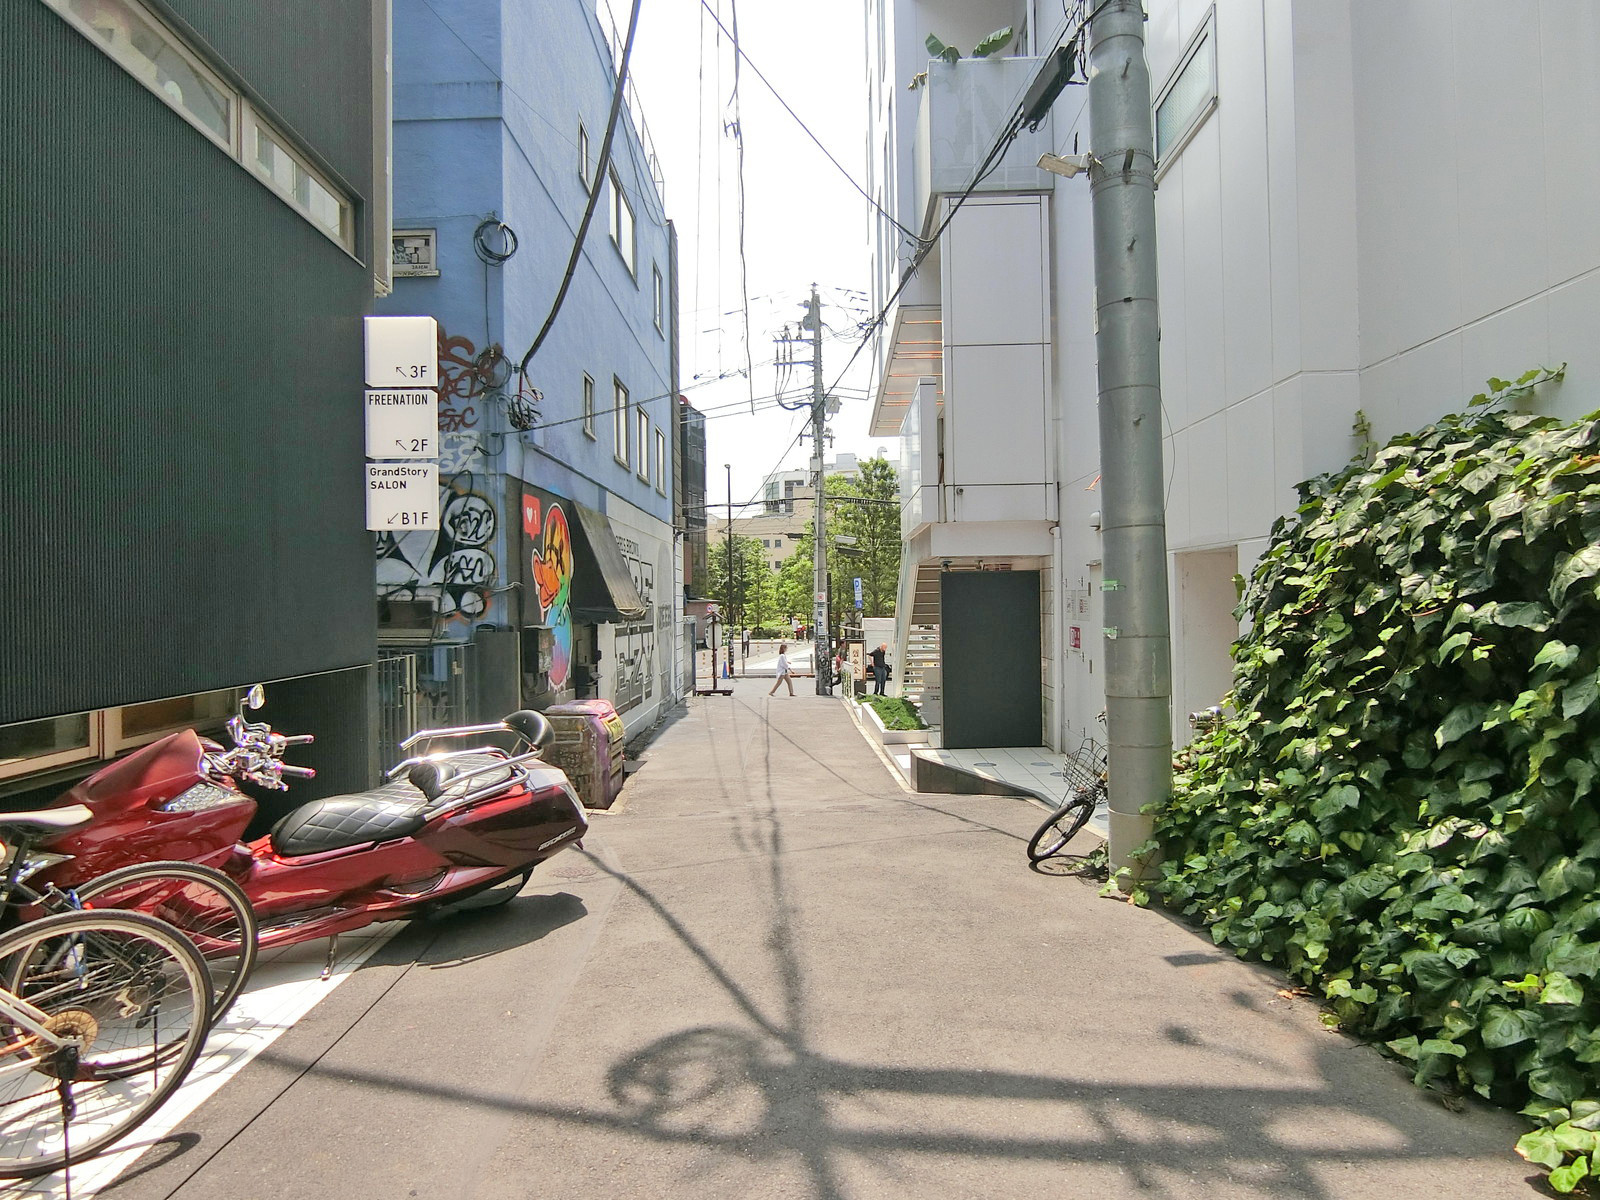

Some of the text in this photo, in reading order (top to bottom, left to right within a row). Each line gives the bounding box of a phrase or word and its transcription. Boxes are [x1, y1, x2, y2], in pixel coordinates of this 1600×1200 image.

[411, 366, 427, 378] 3F
[369, 394, 427, 405] FREENATION
[411, 439, 427, 451] 2F
[370, 467, 428, 477] GrandStory
[371, 481, 406, 489] SALON
[402, 512, 428, 525] B1F
